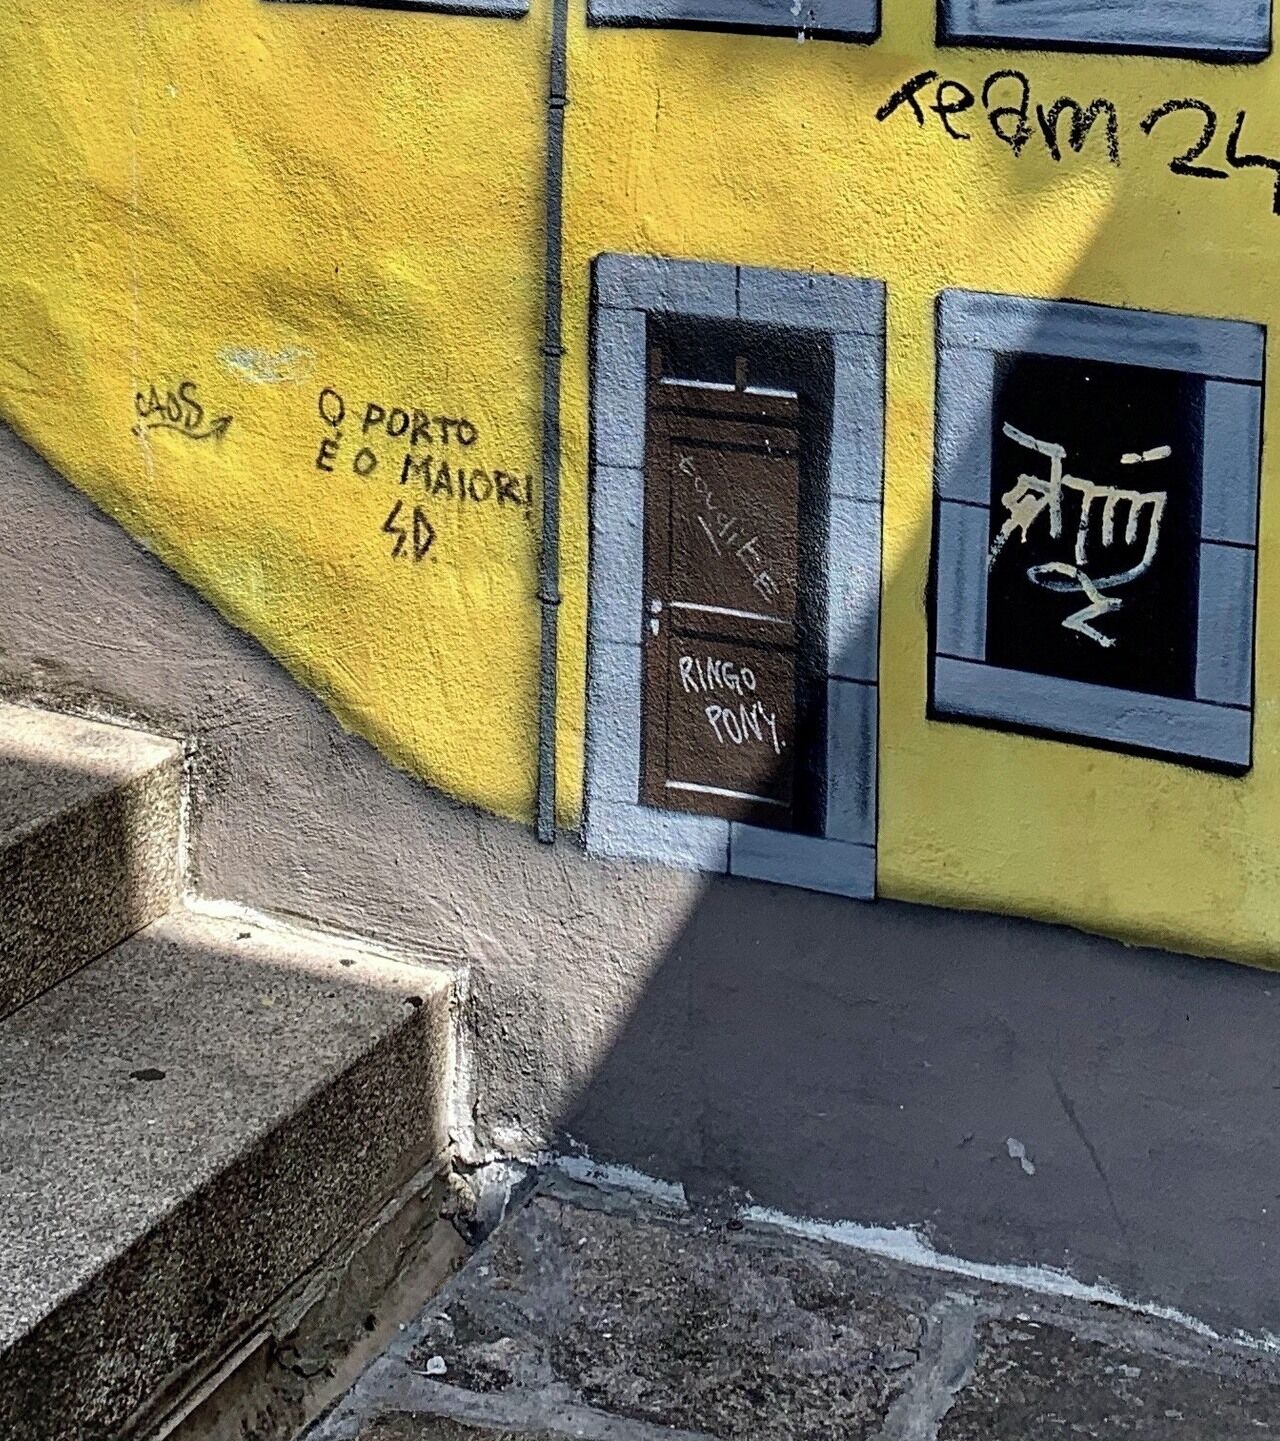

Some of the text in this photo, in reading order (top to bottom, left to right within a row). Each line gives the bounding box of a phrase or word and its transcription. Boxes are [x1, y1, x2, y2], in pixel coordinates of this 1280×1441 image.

[318, 387, 480, 447] O PORTO
[352, 446, 378, 476] O
[679, 655, 757, 696] RINGO
